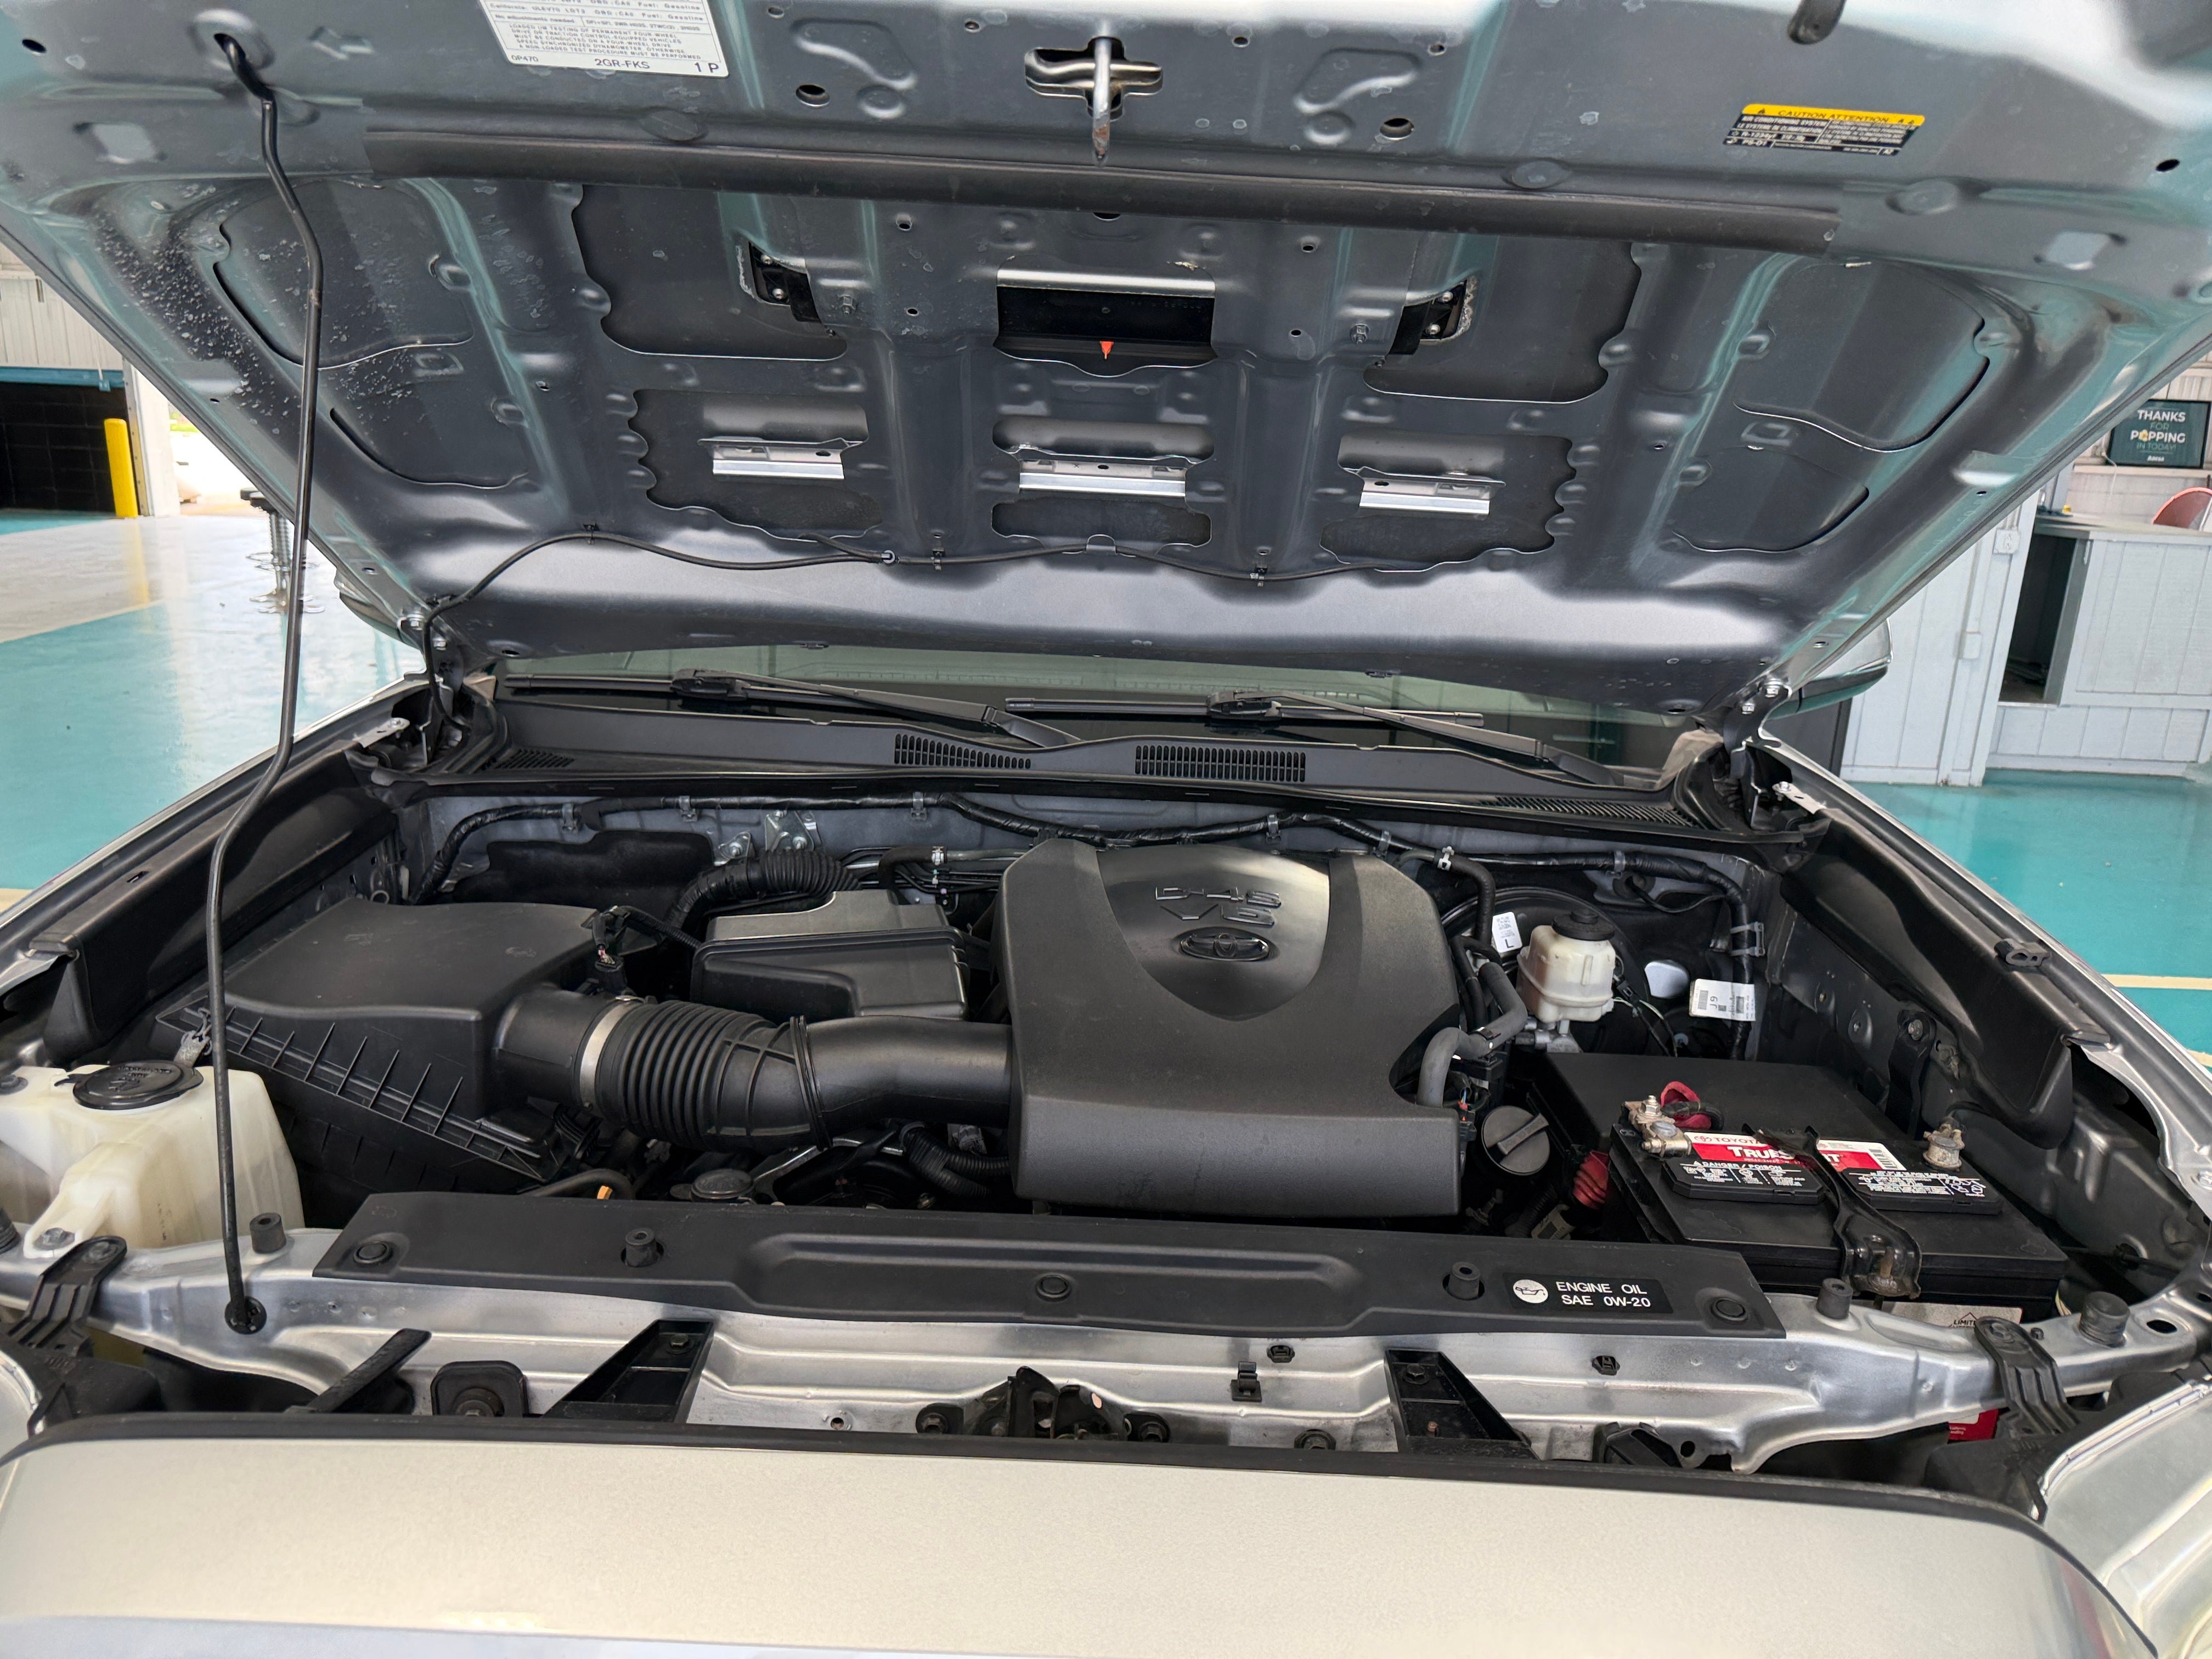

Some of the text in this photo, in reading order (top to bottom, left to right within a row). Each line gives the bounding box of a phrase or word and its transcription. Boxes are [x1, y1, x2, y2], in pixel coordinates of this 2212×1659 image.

[594, 58, 651, 69] 2GR-FKS
[708, 63, 720, 73] P
[1778, 110, 1889, 123] CAUTION ATTENTION
[2137, 410, 2186, 422] THANKS
[2150, 422, 2170, 431] FOR
[2130, 429, 2186, 443] PPPING
[1505, 939, 1514, 949] L
[1556, 1282, 1647, 1295] ENGINE OIL
[1561, 1294, 1651, 1307] SAE 0W-20
